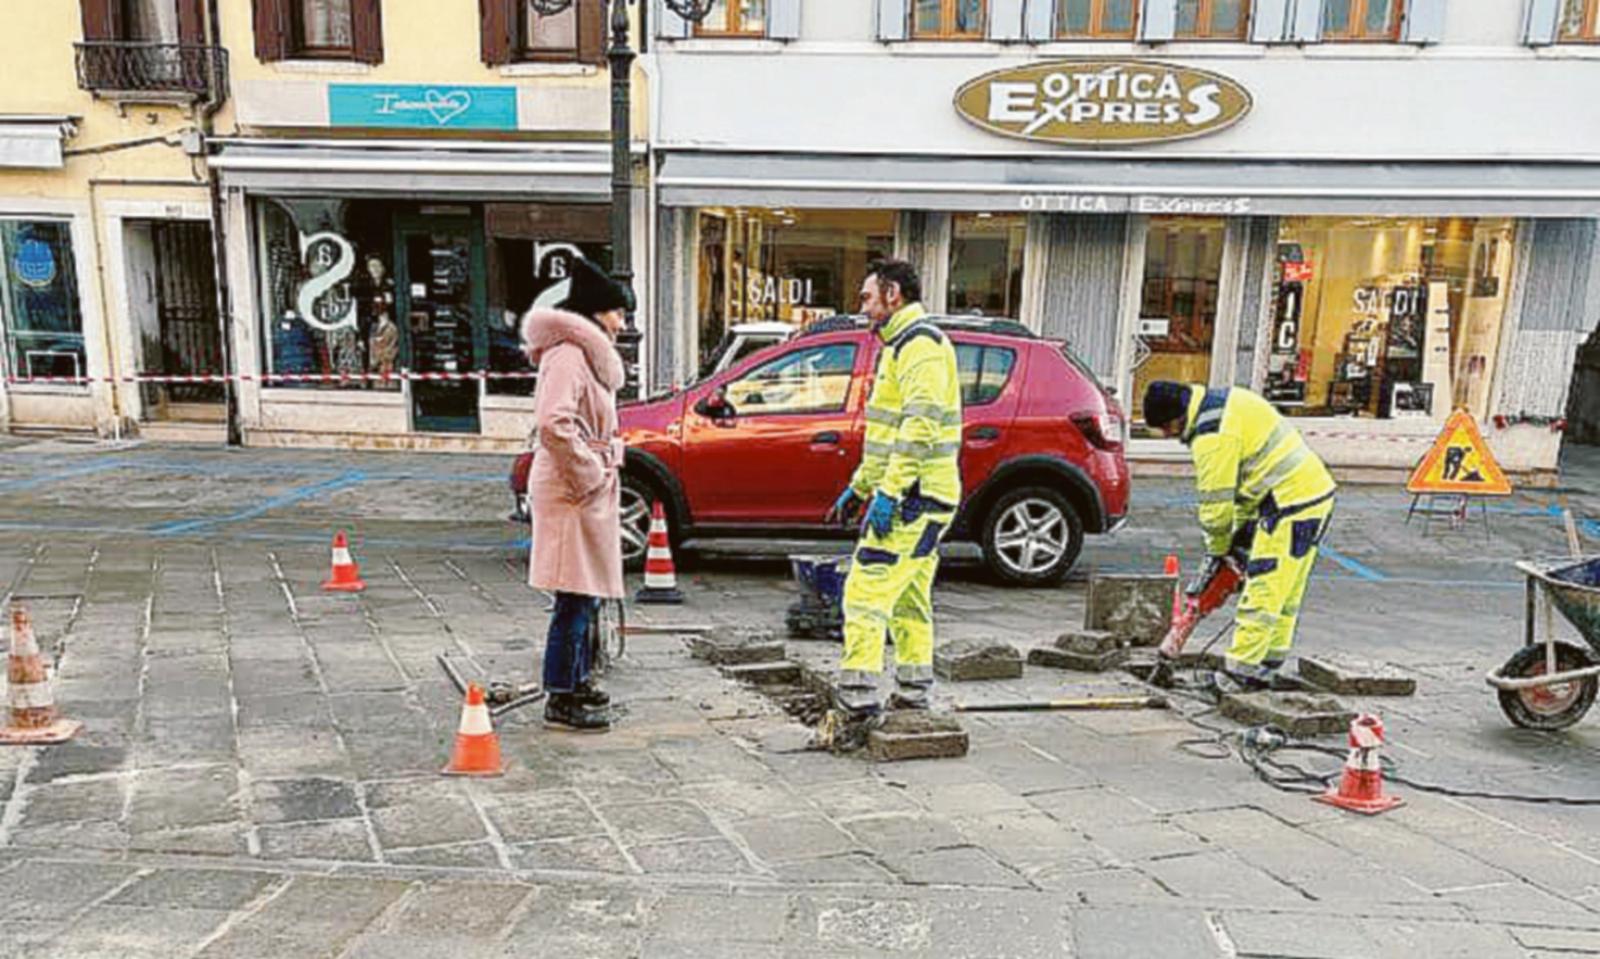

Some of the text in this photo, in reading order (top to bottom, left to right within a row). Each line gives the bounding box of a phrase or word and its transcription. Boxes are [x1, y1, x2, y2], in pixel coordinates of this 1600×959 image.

[1042, 71, 1182, 99] OTTICA
[988, 81, 1222, 135] EXPRESS
[1019, 194, 1109, 212] OTTICA
[748, 274, 813, 305] SALDI
